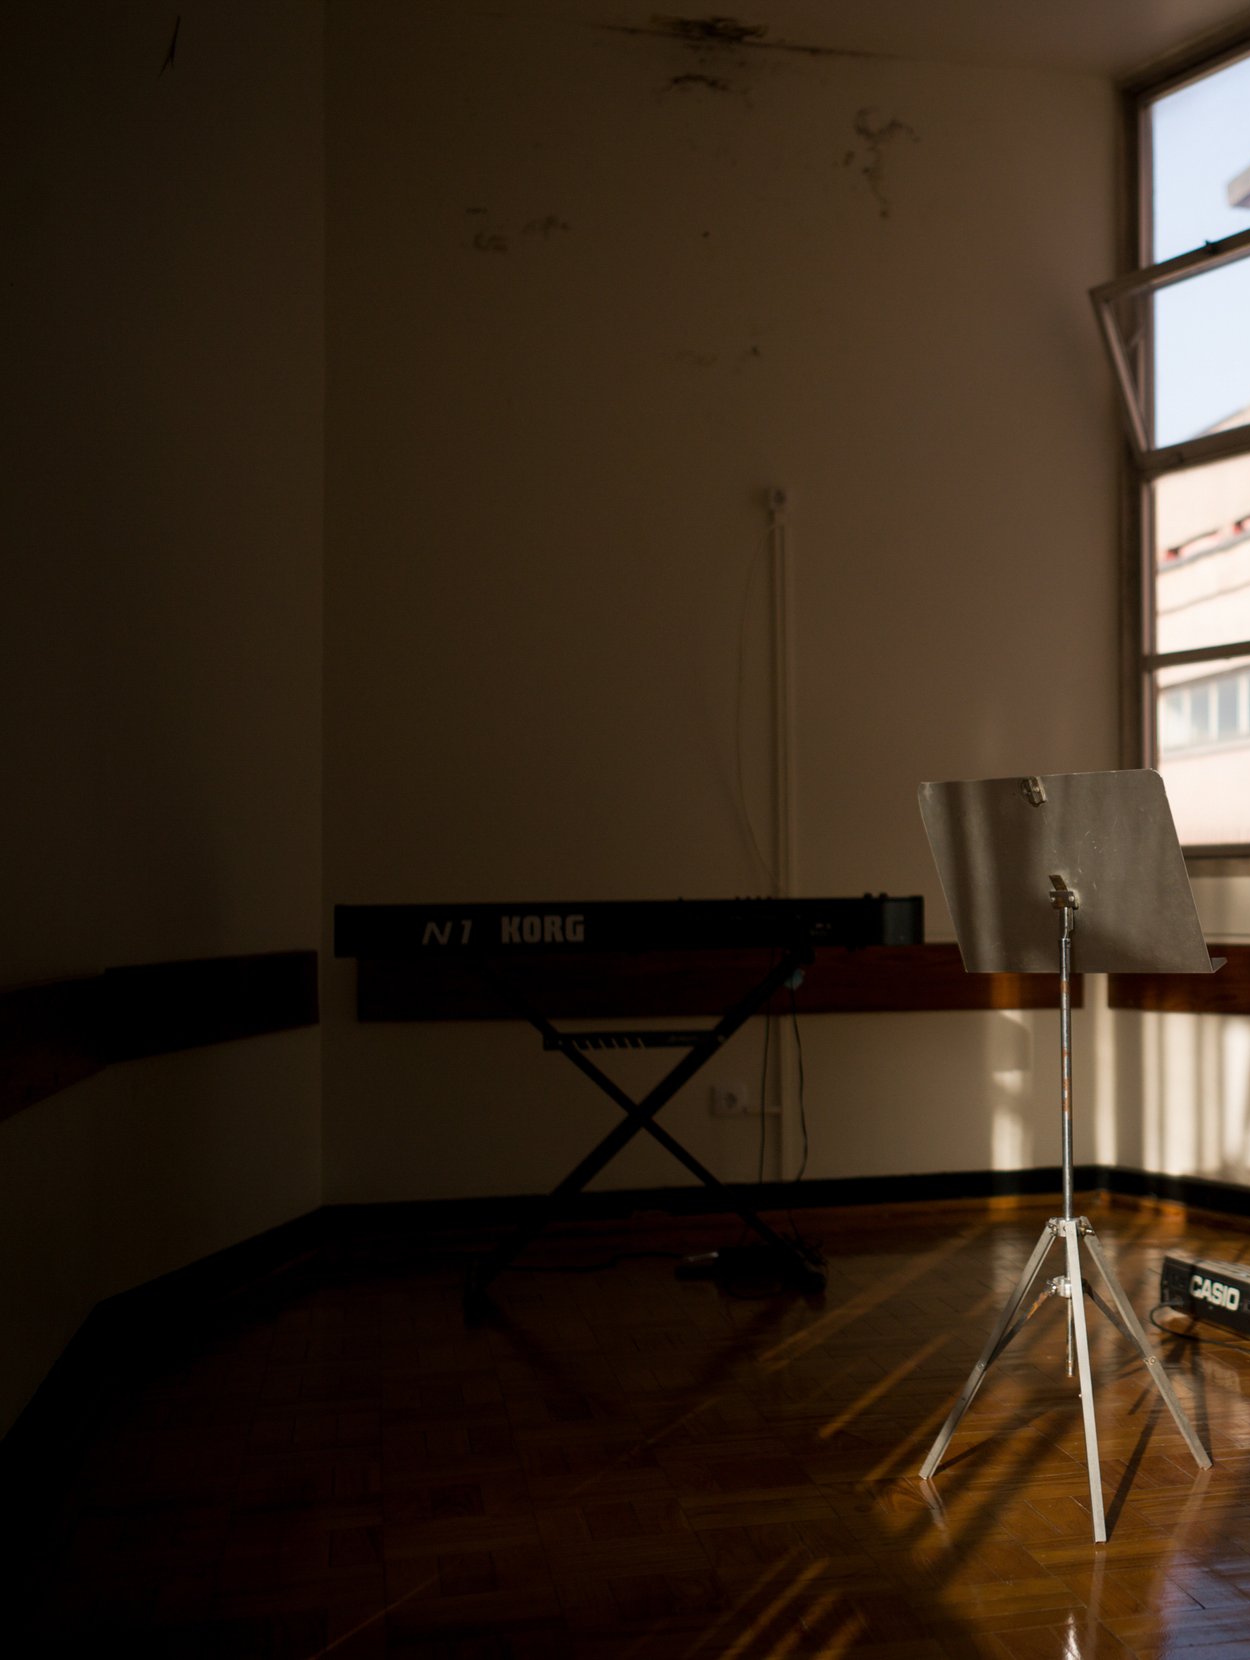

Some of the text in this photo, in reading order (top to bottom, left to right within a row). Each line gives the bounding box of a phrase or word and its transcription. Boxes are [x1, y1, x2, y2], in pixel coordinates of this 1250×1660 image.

[421, 919, 474, 946] N1
[499, 914, 586, 944] KORG
[1189, 1275, 1240, 1312] CASIO
